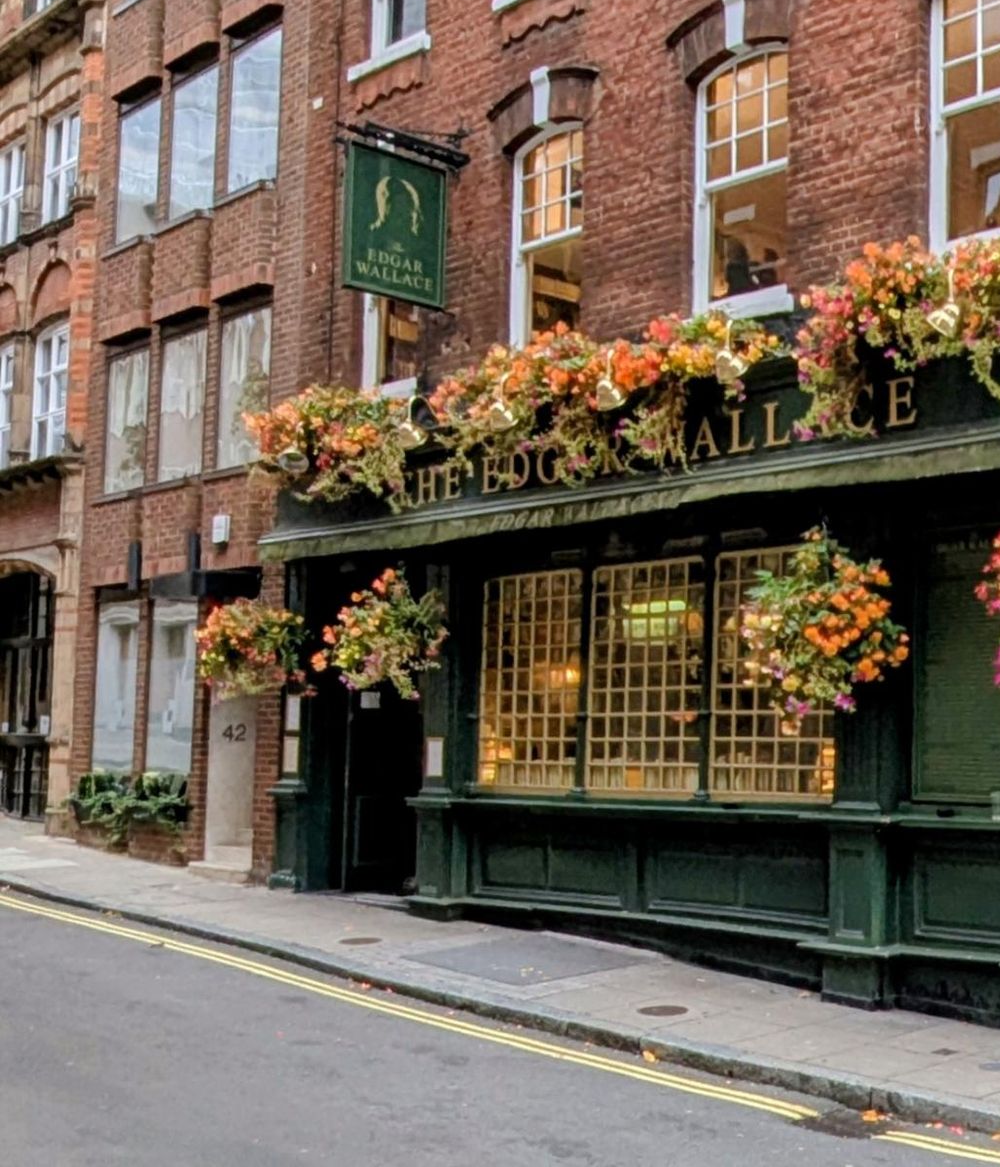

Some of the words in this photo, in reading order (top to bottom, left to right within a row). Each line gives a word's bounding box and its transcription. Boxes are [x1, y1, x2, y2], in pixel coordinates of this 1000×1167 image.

[367, 248, 424, 274] EDGAR
[356, 261, 434, 292] WALLACE
[481, 430, 626, 496] EDGR
[652, 375, 918, 464] ALLCE
[222, 723, 248, 743] 42
